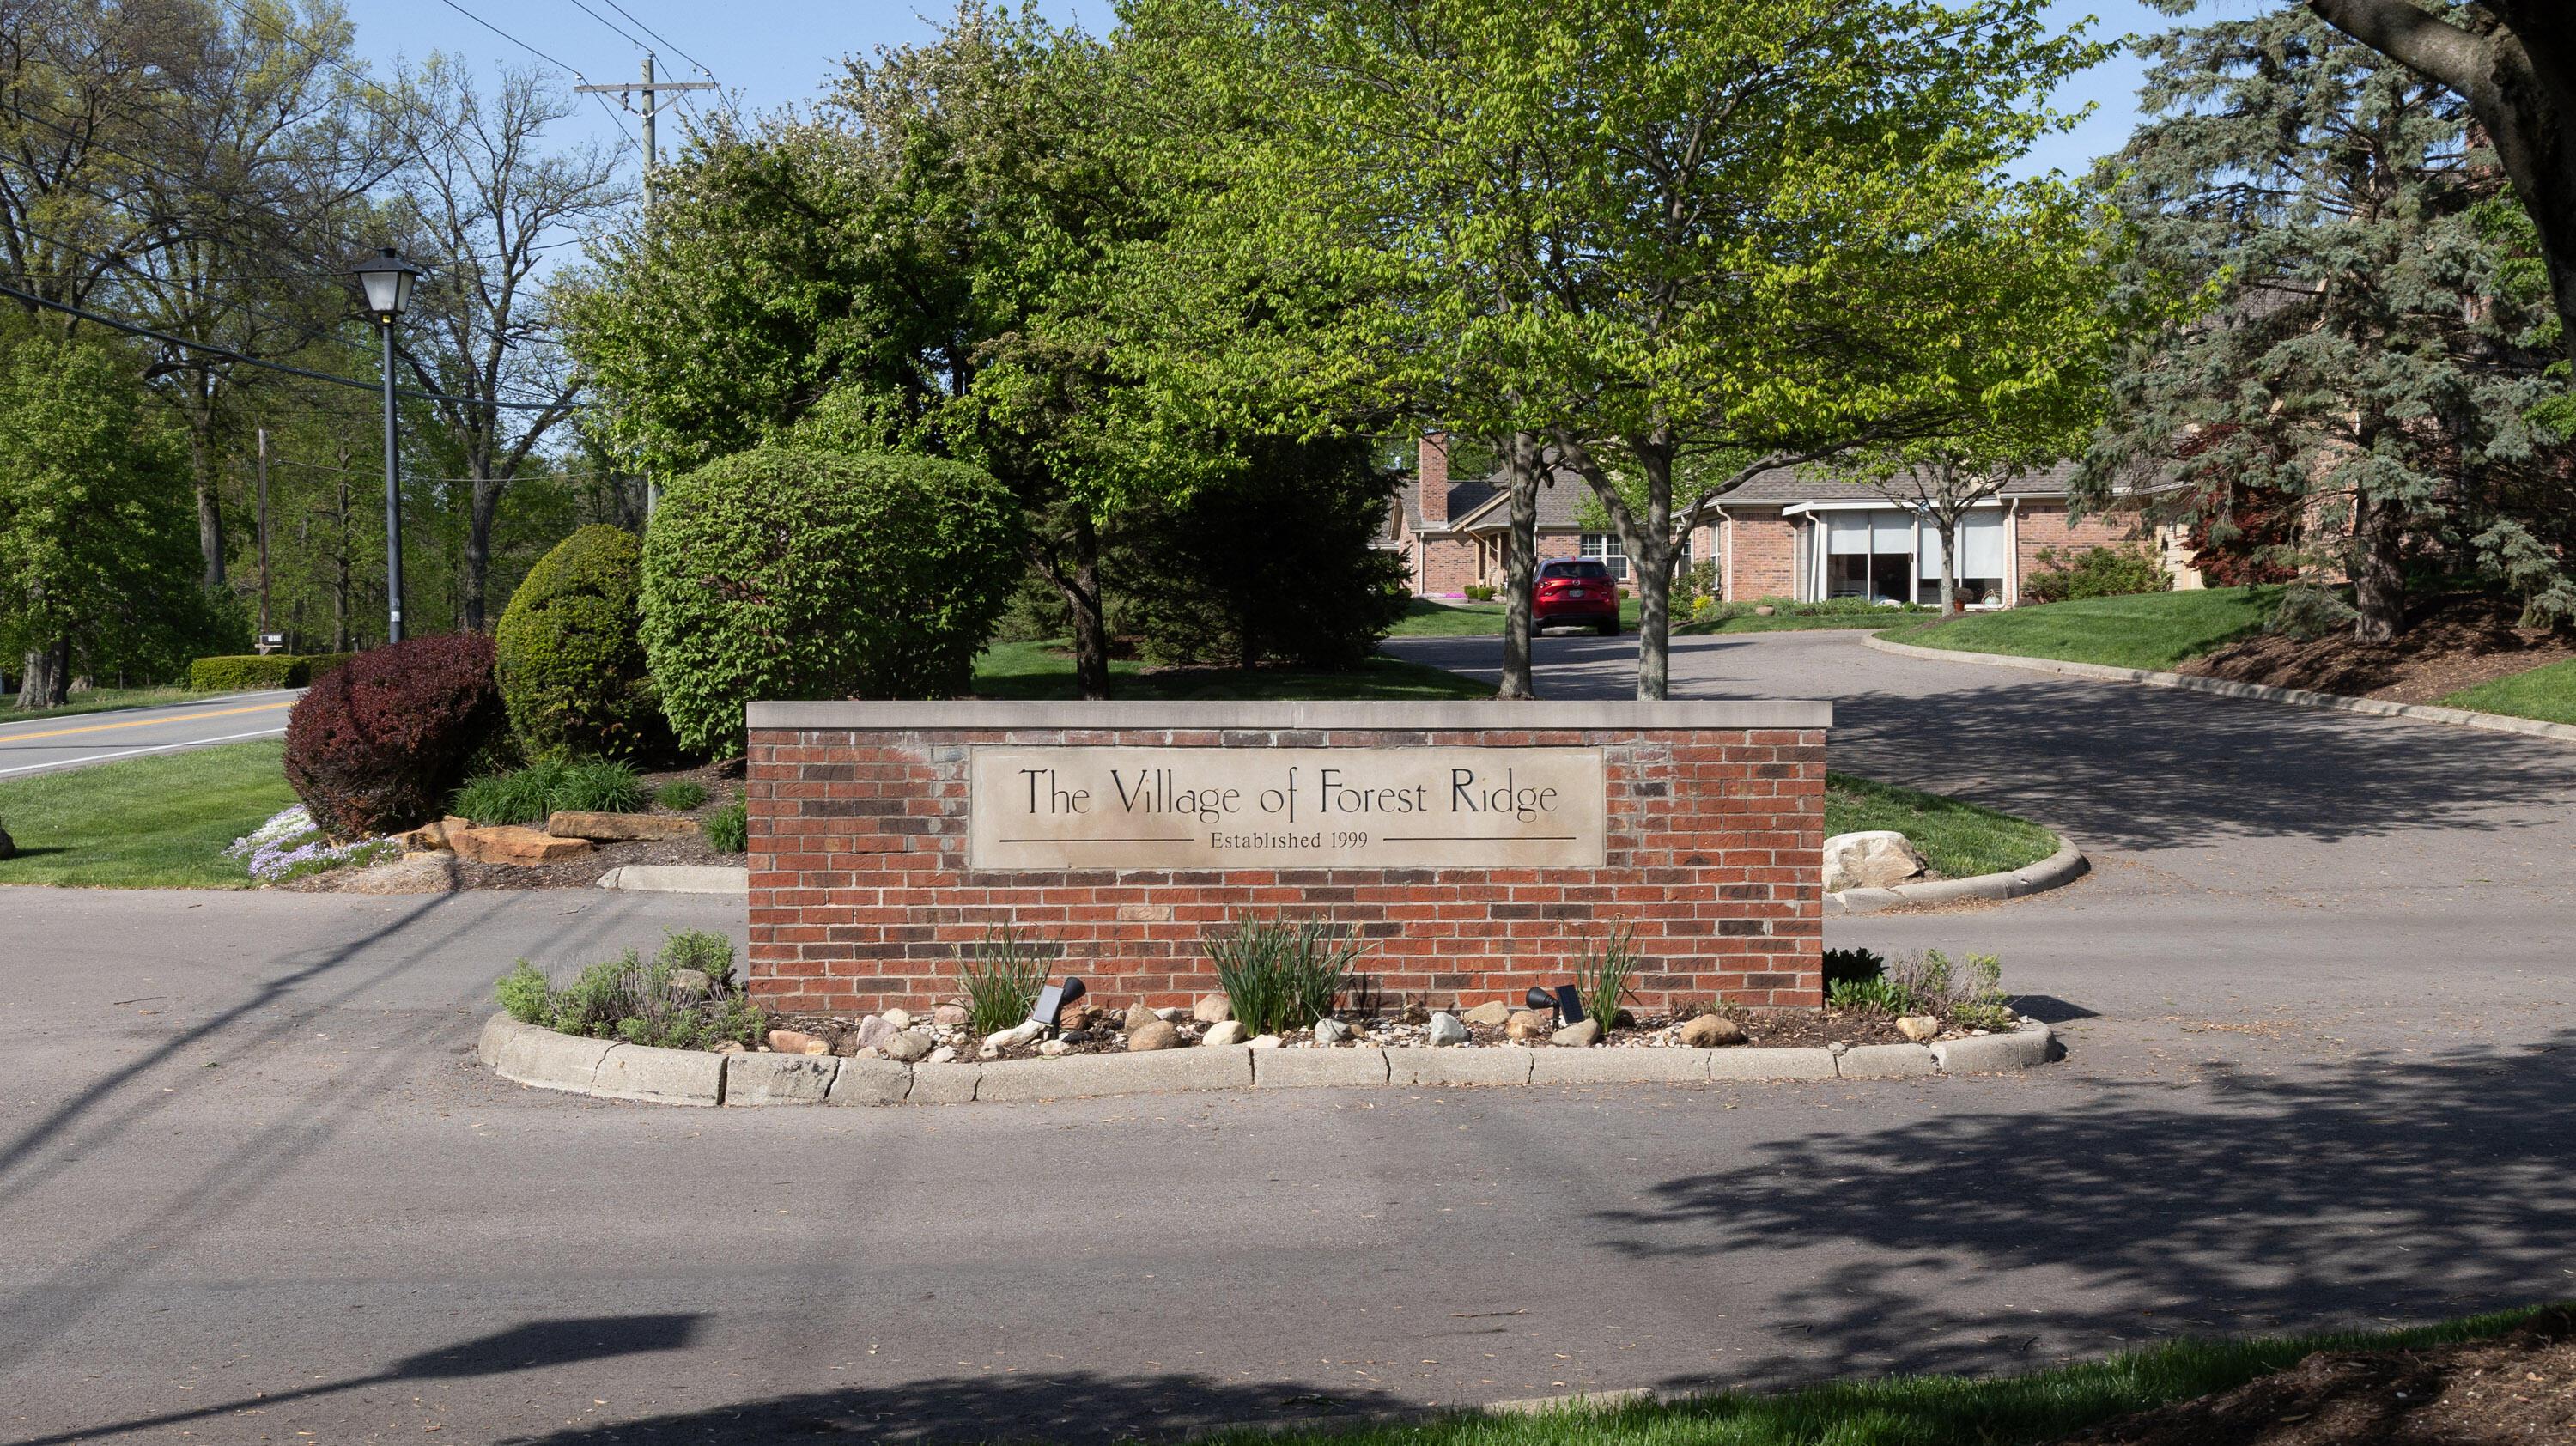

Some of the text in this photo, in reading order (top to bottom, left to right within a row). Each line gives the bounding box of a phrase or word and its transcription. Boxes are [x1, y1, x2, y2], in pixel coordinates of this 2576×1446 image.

[1018, 766, 1558, 824] The Village of Forest Ridge
[1210, 831, 1368, 849] Established 1999
